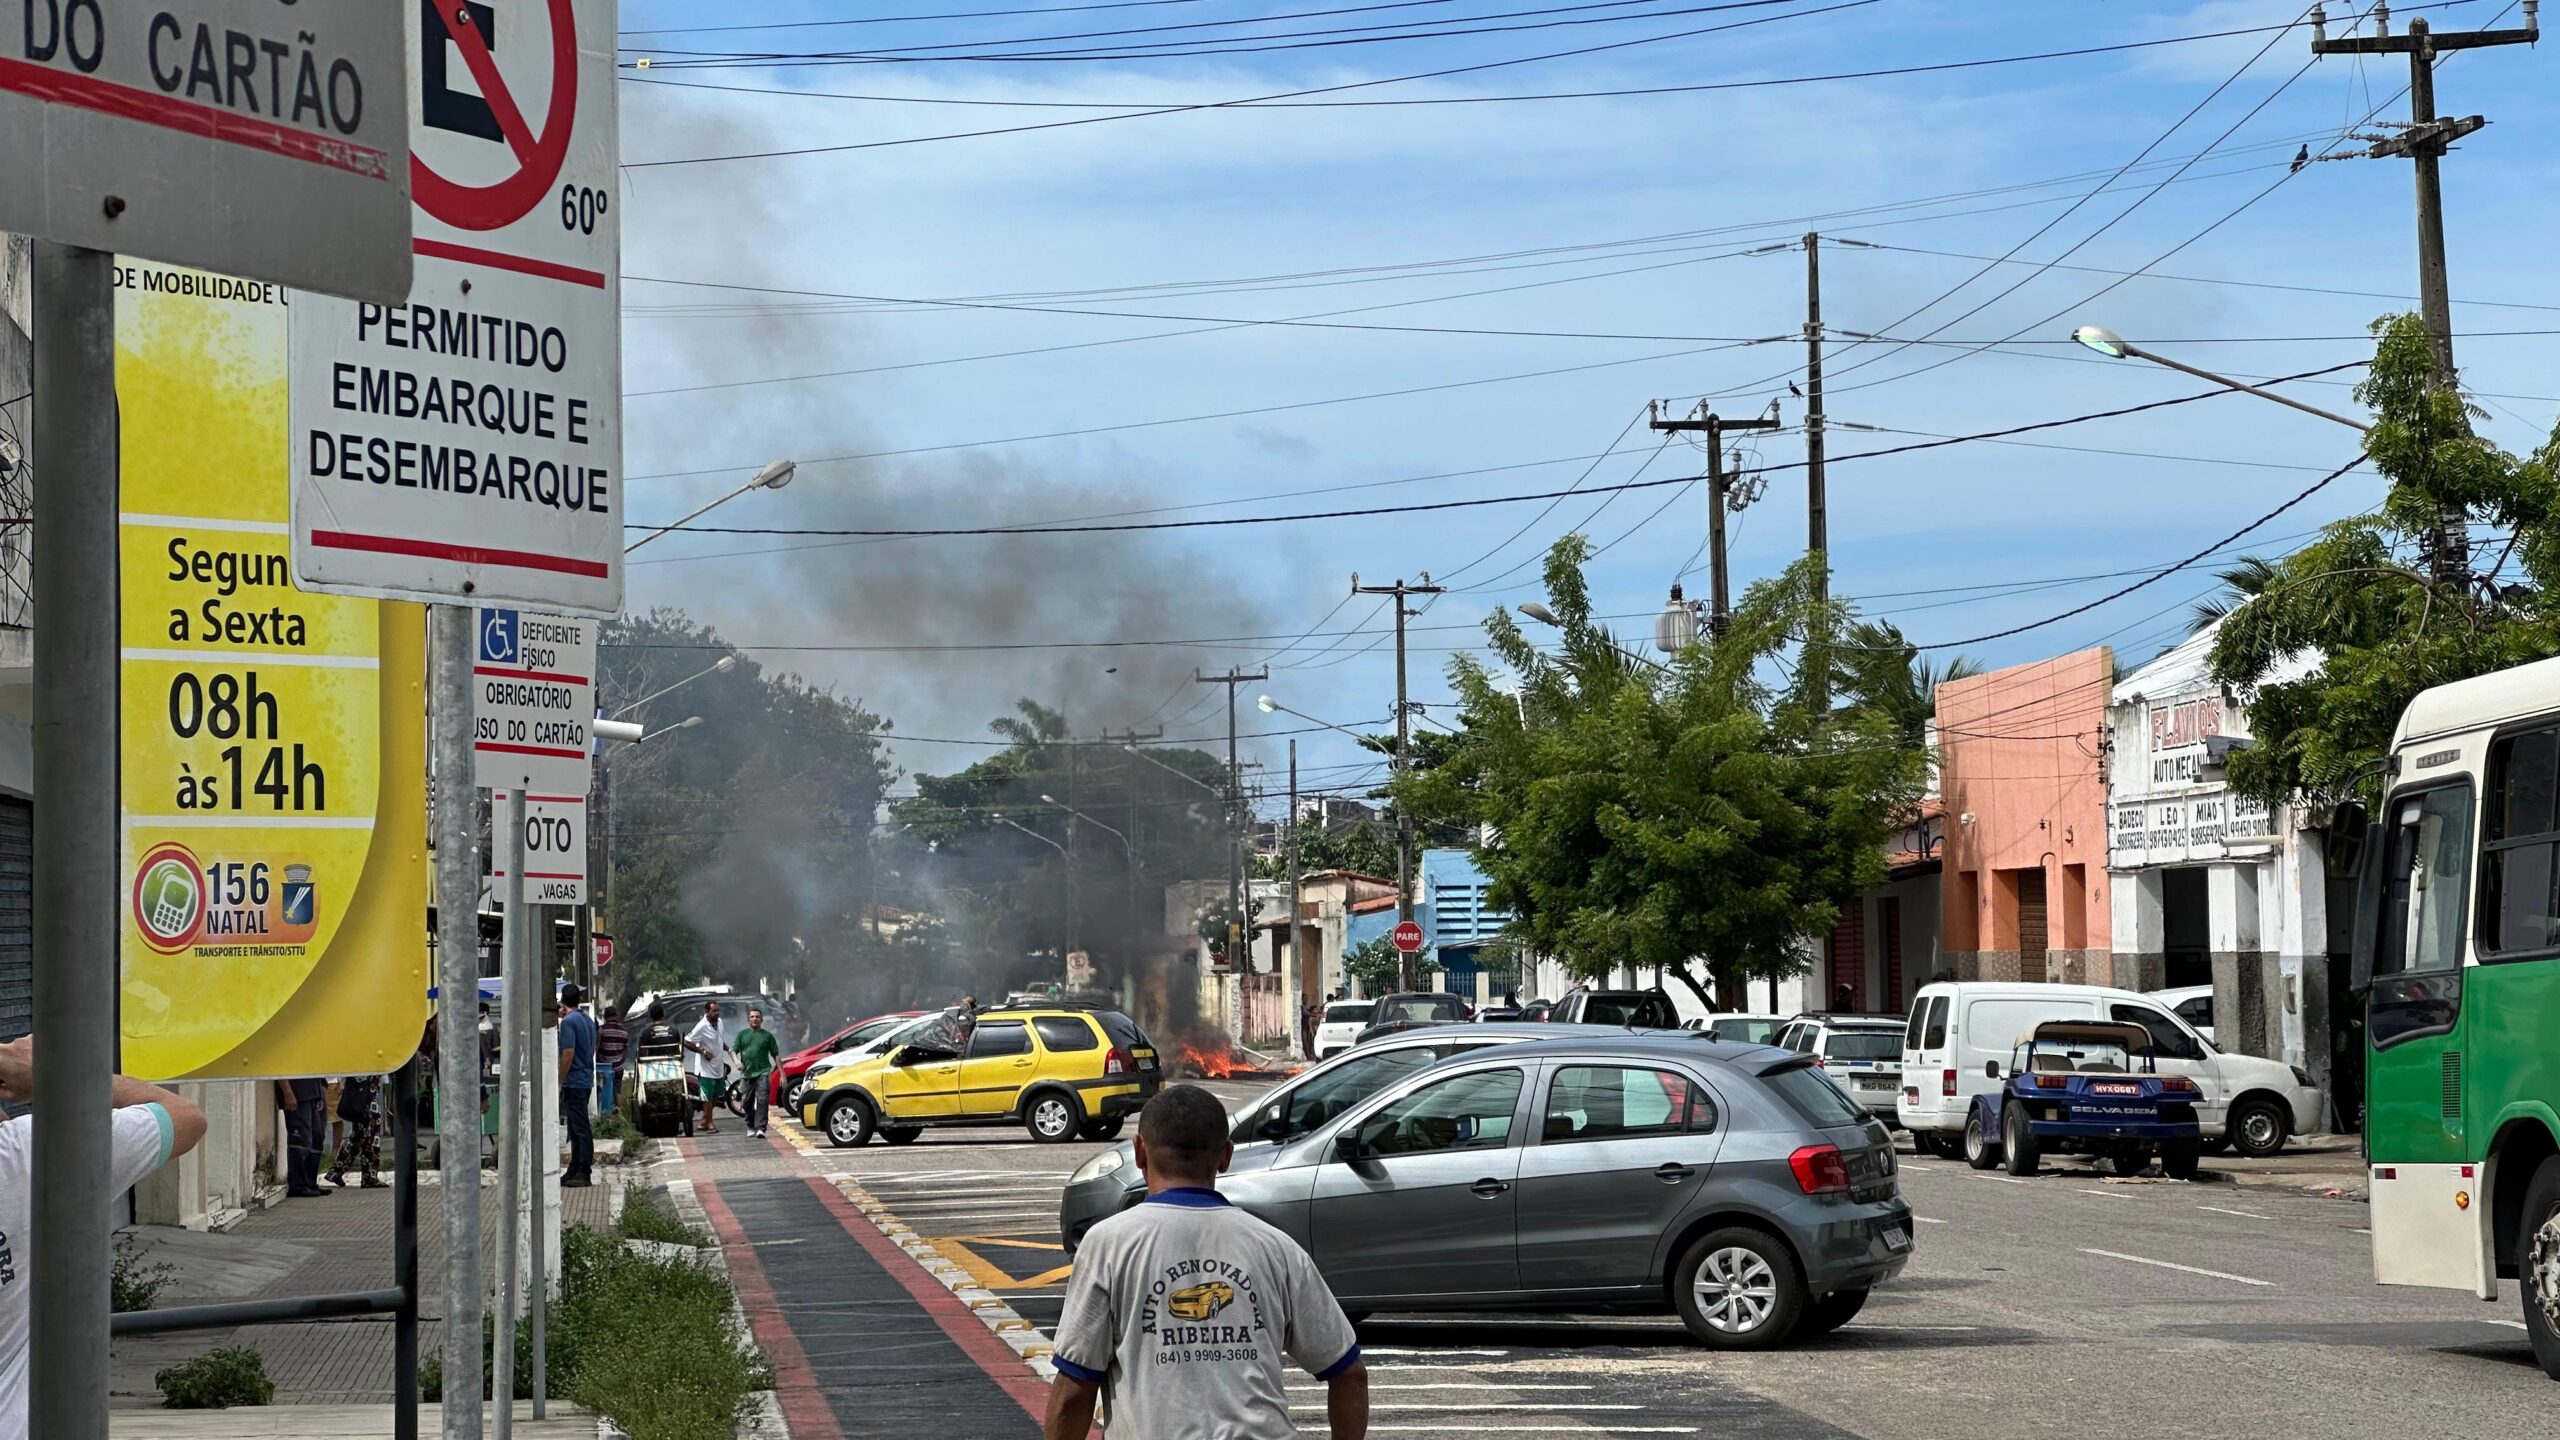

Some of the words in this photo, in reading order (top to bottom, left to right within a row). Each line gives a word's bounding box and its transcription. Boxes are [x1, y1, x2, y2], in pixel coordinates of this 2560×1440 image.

[25, 0, 104, 74] DO
[148, 12, 363, 135] CARTÃO
[143, 270, 273, 304] MOBILIDADE
[359, 301, 566, 373] PERMITIDO
[333, 362, 556, 435] EMBARQUE
[568, 398, 589, 445] E
[310, 430, 609, 514] DESEMBARQUE
[168, 608, 189, 642] a
[202, 598, 306, 647] Sexta
[521, 621, 581, 646] DEFICIENTE
[521, 643, 556, 668] FÍSICO
[169, 671, 278, 740] 08h
[486, 681, 572, 710] OBRIGATÓRIO
[507, 720, 526, 742] DO
[534, 720, 584, 746] CARTÃO
[2153, 758, 2174, 784] AUTO
[2159, 807, 2178, 826] LEO
[525, 816, 572, 853] OTO
[206, 862, 270, 905] 156
[543, 884, 577, 900] VAGAS
[206, 910, 269, 935] NATAL
[1396, 932, 1420, 941] PARE
[194, 946, 242, 958] TRANSPORTE
[243, 947, 248, 957] E
[249, 944, 306, 957] TRÂNSITO/STTU
[2071, 1105, 2158, 1115] SELVAGEM
[1142, 1280, 1166, 1335] AUTO
[1162, 1326, 1252, 1346] RIBEIRA
[1155, 1350, 1181, 1367] (84)
[1183, 1350, 1191, 1362] 9
